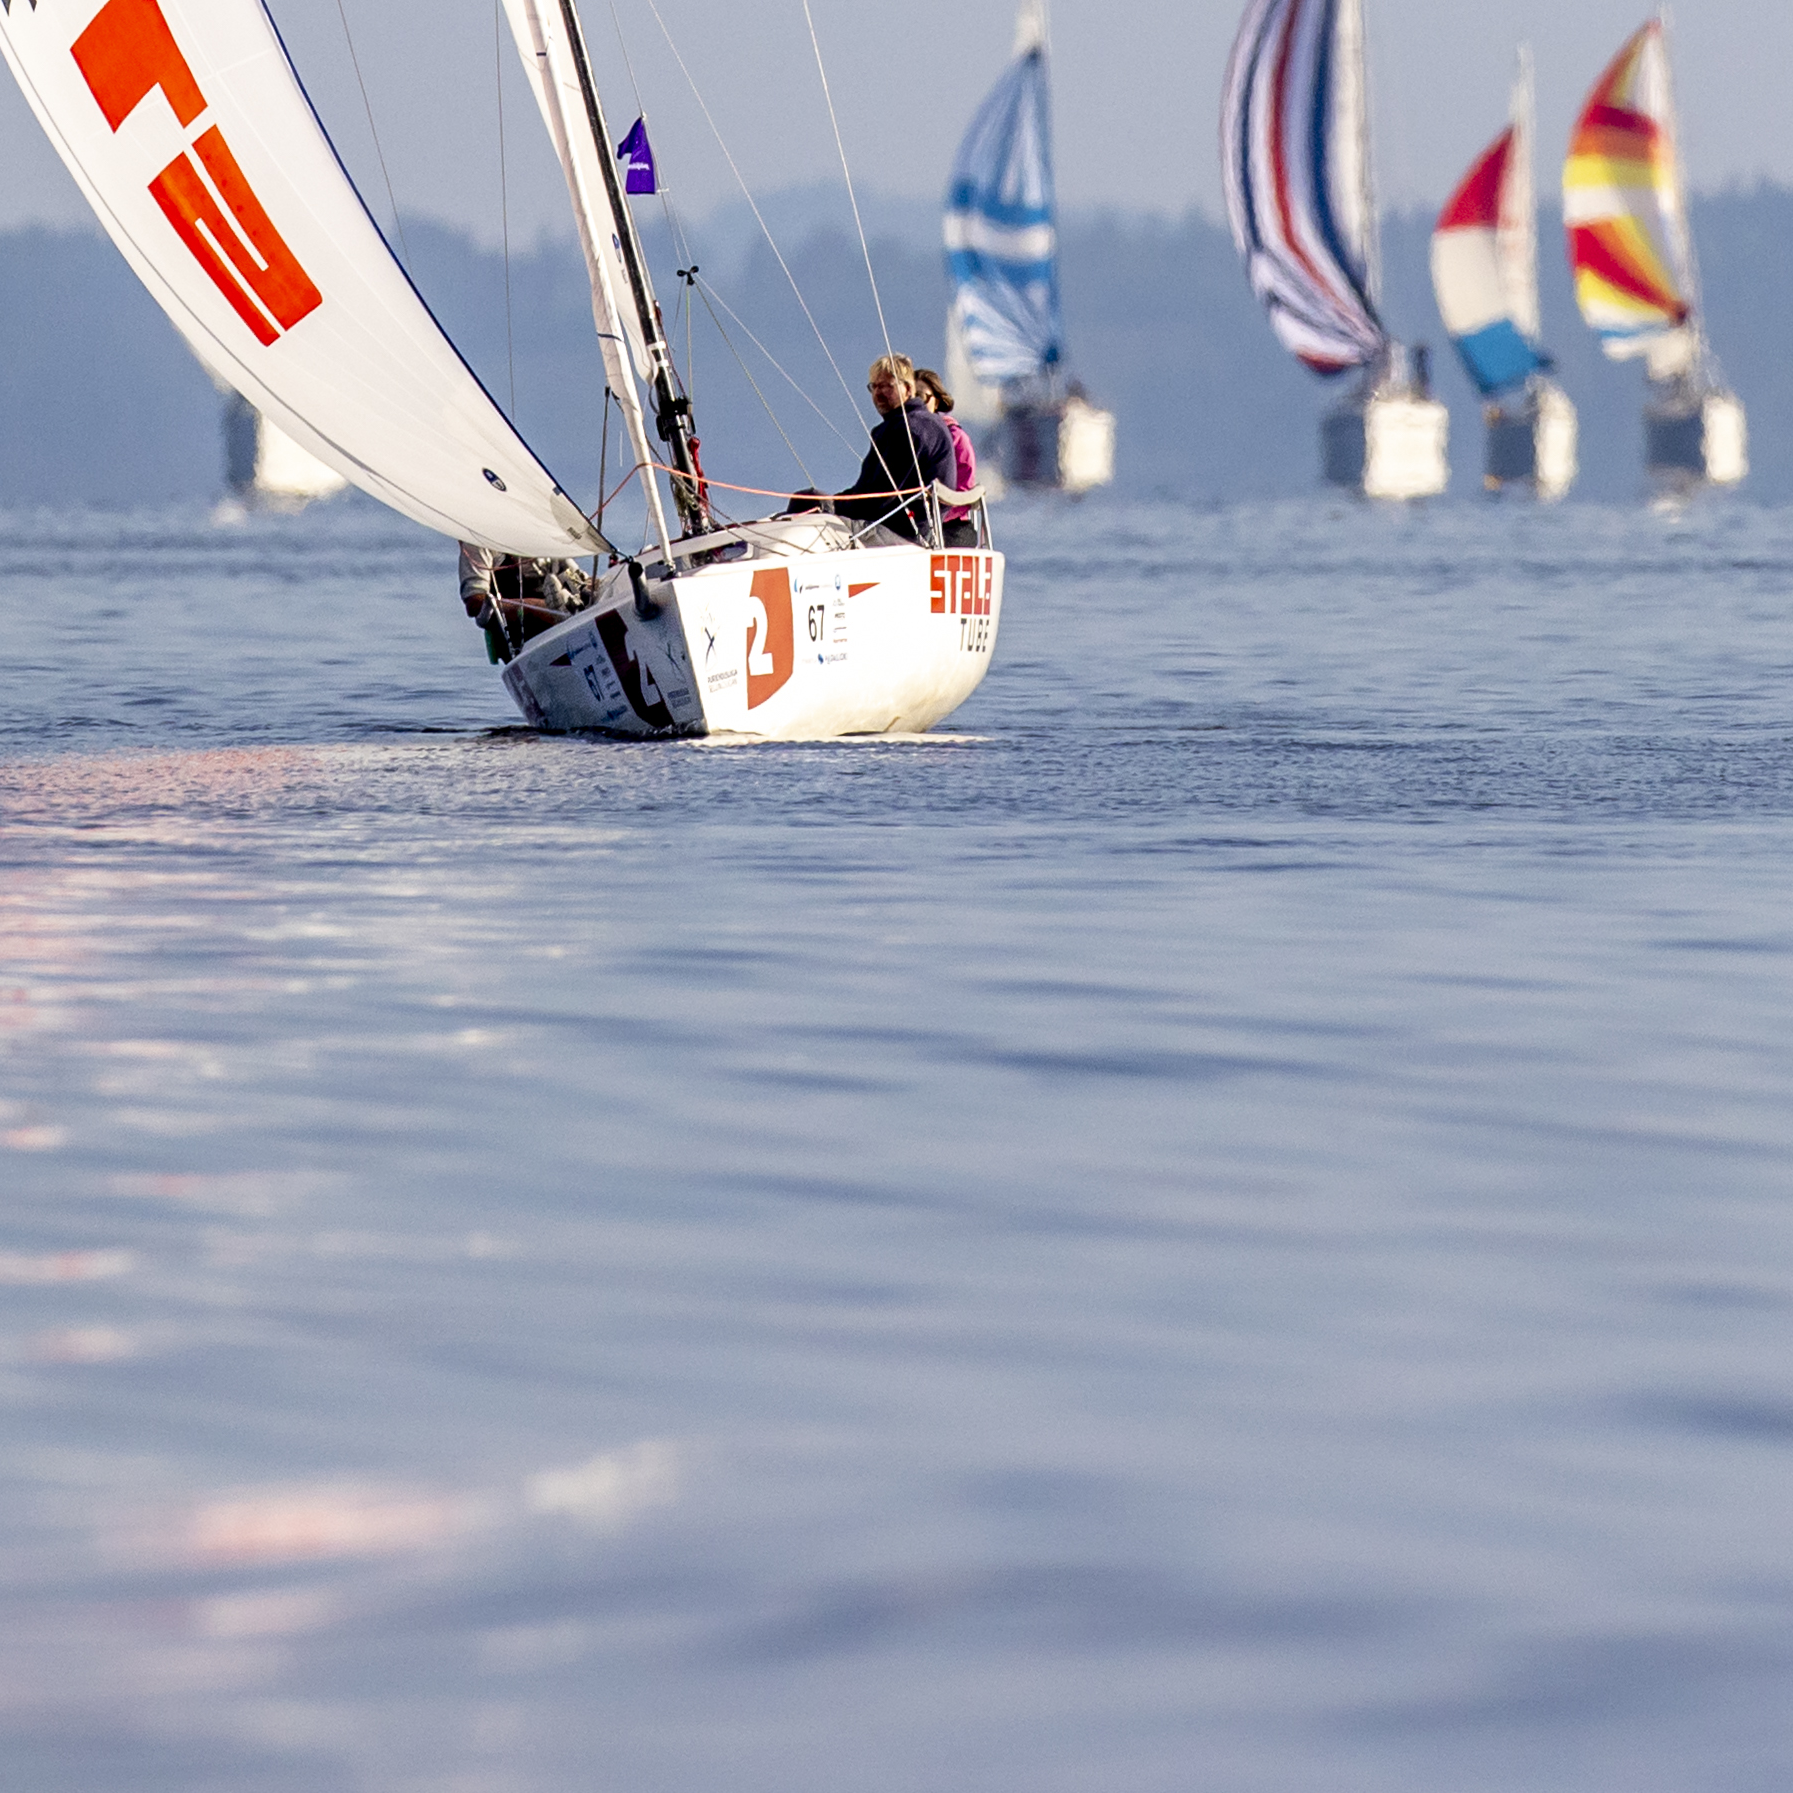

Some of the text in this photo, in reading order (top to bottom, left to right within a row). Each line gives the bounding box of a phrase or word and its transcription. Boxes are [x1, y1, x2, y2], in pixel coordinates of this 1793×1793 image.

[747, 595, 774, 677] 2
[808, 604, 825, 642] 67
[959, 617, 990, 652] TUBE
